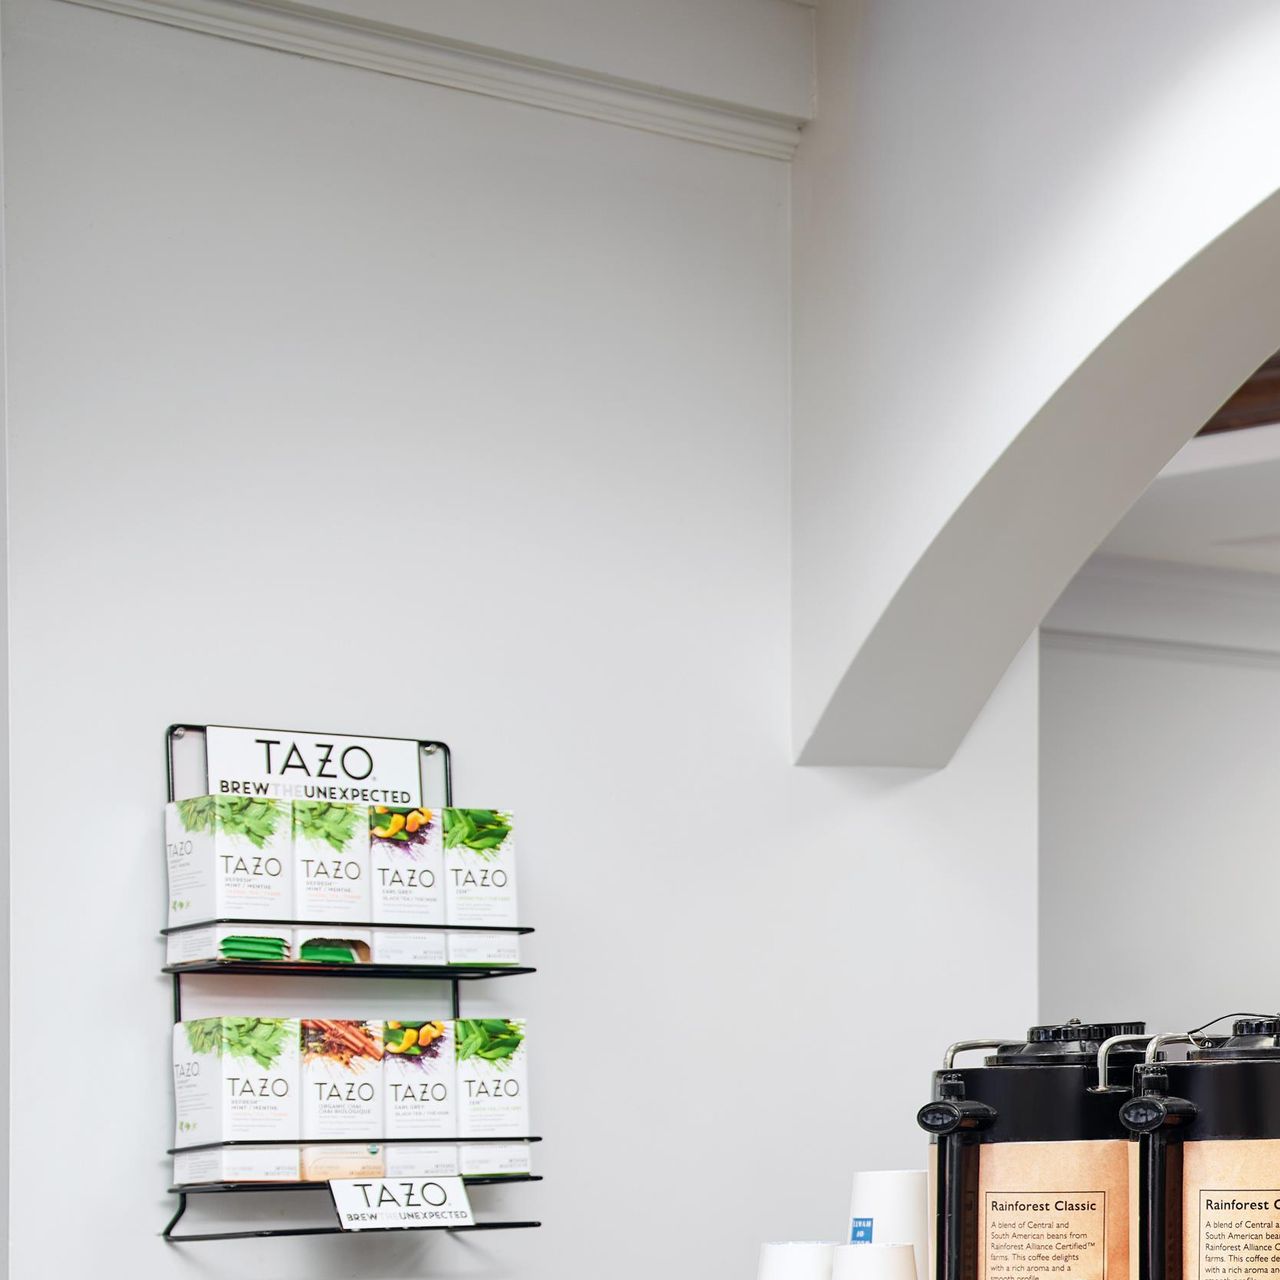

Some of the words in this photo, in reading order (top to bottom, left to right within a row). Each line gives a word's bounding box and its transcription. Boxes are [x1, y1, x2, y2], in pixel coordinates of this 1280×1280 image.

[255, 738, 373, 781] TAZO
[220, 780, 270, 795] BREW
[304, 784, 411, 804] UNEXPECTED
[220, 855, 282, 877] TAZO
[301, 859, 361, 880] TAZO
[377, 868, 435, 888] TAZO
[451, 868, 507, 888] TAZO
[226, 1077, 289, 1098] TAZO
[314, 1082, 375, 1102] TAZO
[390, 1082, 447, 1102] TAZO
[464, 1078, 520, 1098] TAZO
[353, 1182, 447, 1208] TAZO
[991, 1200, 1050, 1212] Rainforest
[1054, 1200, 1097, 1211] Classic
[1206, 1199, 1269, 1210] Rainforest
[398, 1210, 468, 1221] UNEXPECTED
[1018, 1221, 1026, 1229] of
[1028, 1221, 1054, 1229] Central
[1056, 1221, 1070, 1229] and
[1205, 1221, 1211, 1229] A
[1214, 1220, 1233, 1229] blend
[1235, 1220, 1243, 1229] of
[1244, 1220, 1273, 1229] Central
[990, 1232, 1010, 1240] South
[1012, 1232, 1045, 1240] American
[1046, 1232, 1067, 1240] beans
[1069, 1231, 1088, 1239] from
[1205, 1232, 1226, 1240] South
[1228, 1232, 1264, 1240] American
[990, 1242, 1024, 1251] Rainforest
[1026, 1243, 1053, 1251] Alliance
[1205, 1243, 1241, 1252] Rainforest
[1243, 1243, 1273, 1252] Alliance
[1052, 1254, 1079, 1263] delights
[1228, 1254, 1244, 1263] This
[1246, 1254, 1269, 1263] coffee
[990, 1264, 1004, 1272] with
[1012, 1264, 1025, 1272] rich
[1052, 1264, 1065, 1272] and
[1205, 1266, 1220, 1274] with
[1228, 1266, 1242, 1274] rich
